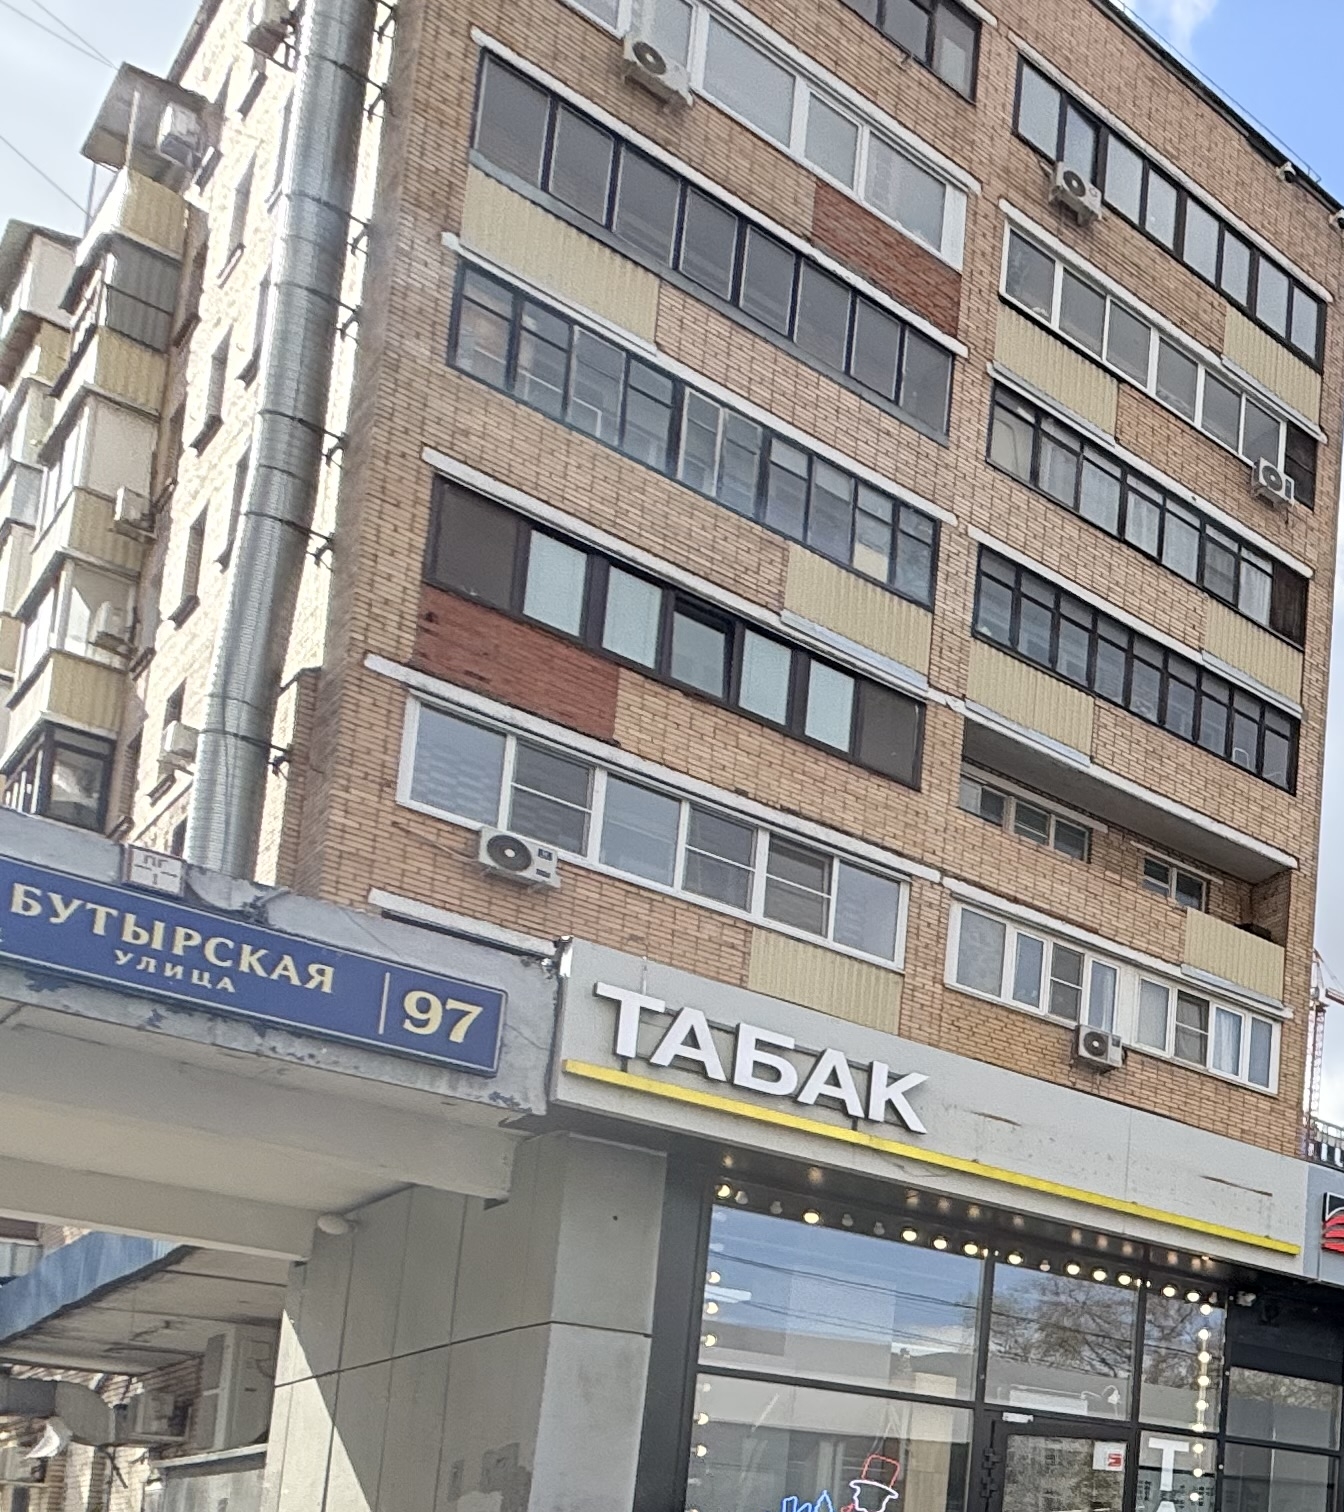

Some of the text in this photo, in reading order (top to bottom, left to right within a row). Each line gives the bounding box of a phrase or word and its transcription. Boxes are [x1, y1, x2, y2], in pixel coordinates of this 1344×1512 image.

[10, 882, 335, 994] БУТЫРСКАЯ
[114, 949, 236, 993] УЛИЦА
[402, 990, 484, 1044] 97
[595, 982, 930, 1134] ТАБАК
